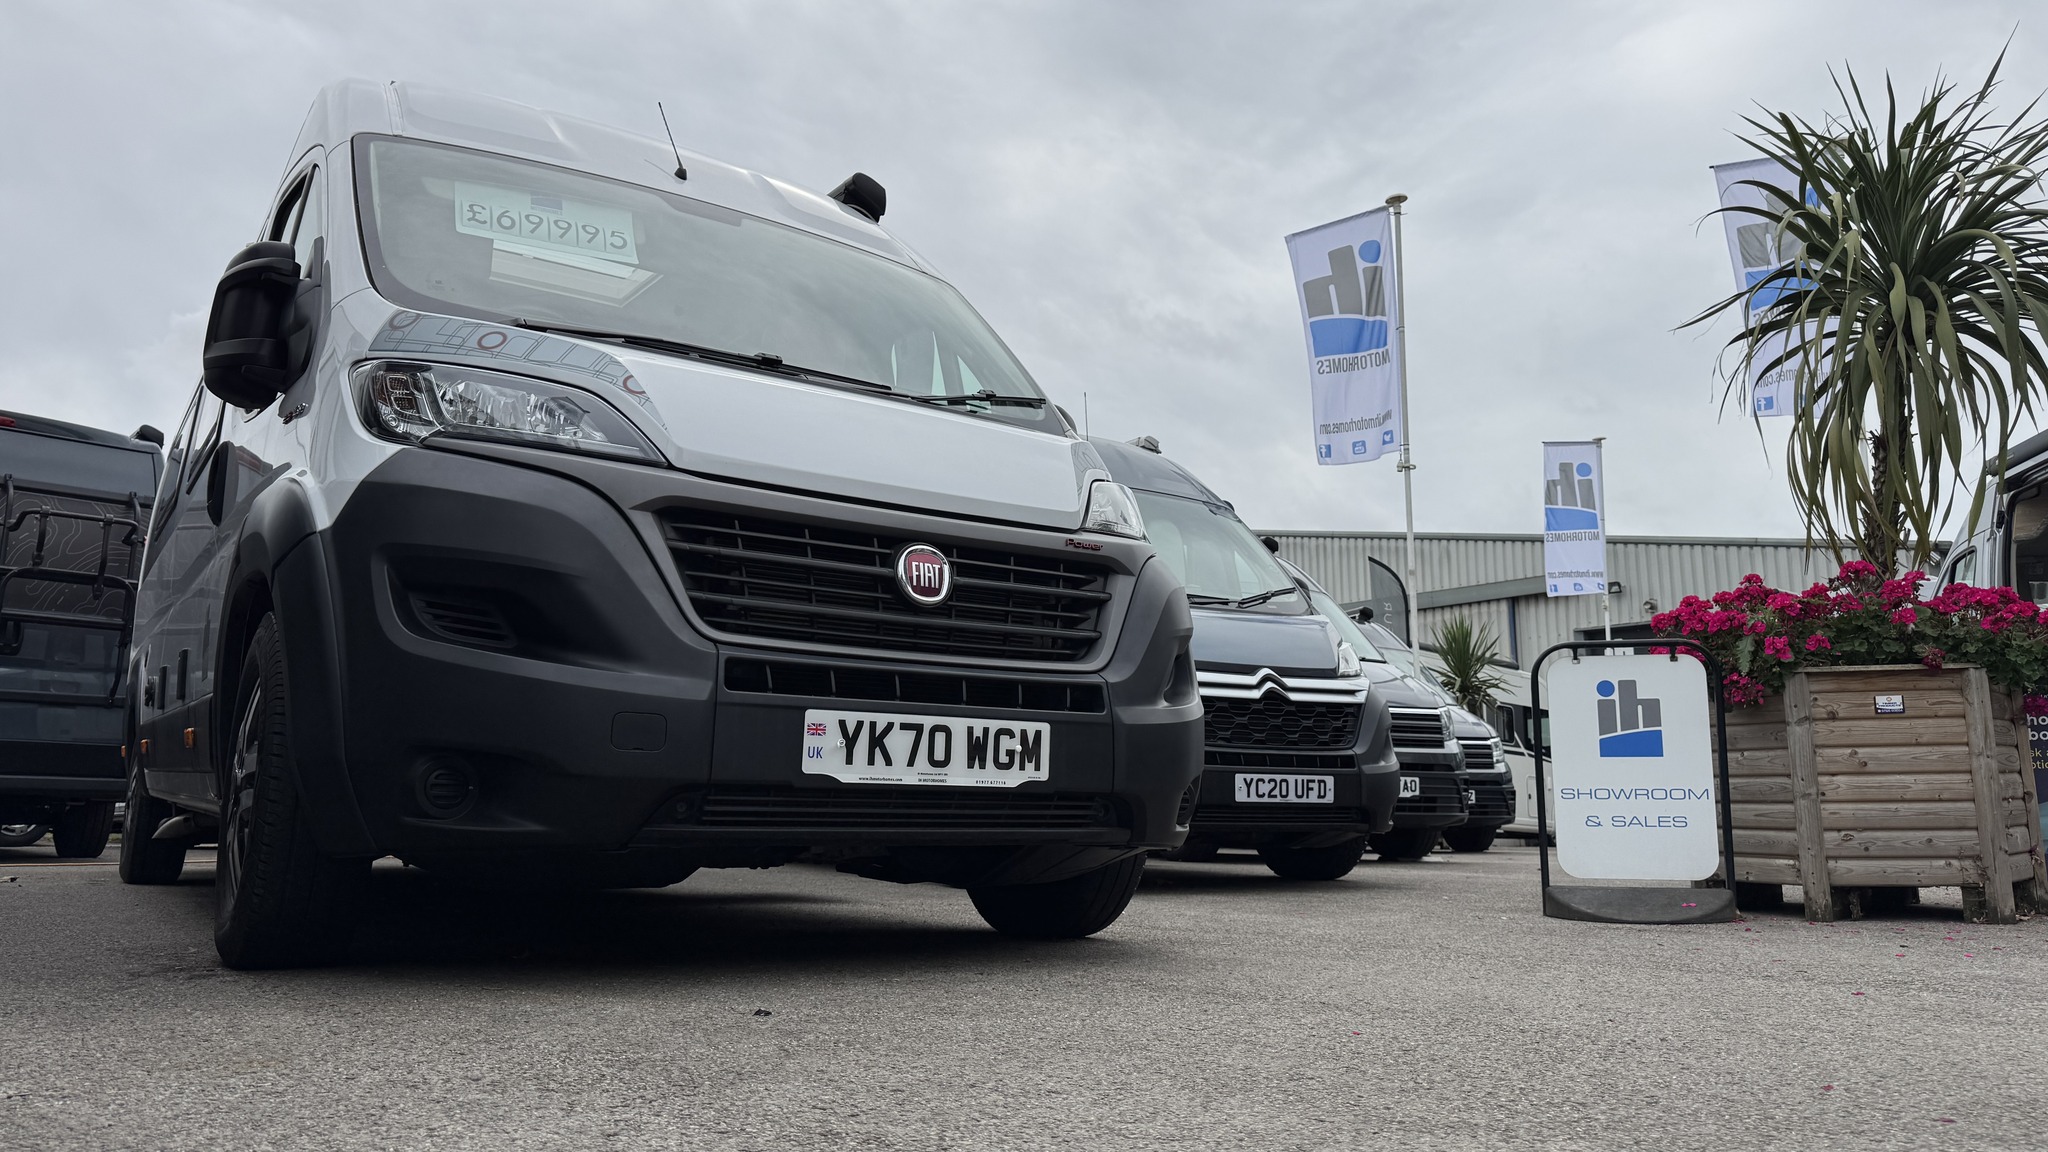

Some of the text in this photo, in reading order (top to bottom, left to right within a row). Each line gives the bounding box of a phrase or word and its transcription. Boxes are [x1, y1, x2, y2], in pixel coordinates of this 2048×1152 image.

[1065, 538, 1104, 551] Power
[912, 561, 941, 589] FIAT
[1596, 680, 1662, 736] ih
[807, 746, 823, 759] UK
[838, 719, 1042, 772] YK70 WGM
[1243, 778, 1327, 799] YC20 UFD
[1560, 788, 1710, 800] SHOWROOM
[1585, 815, 1688, 828] & SALES
